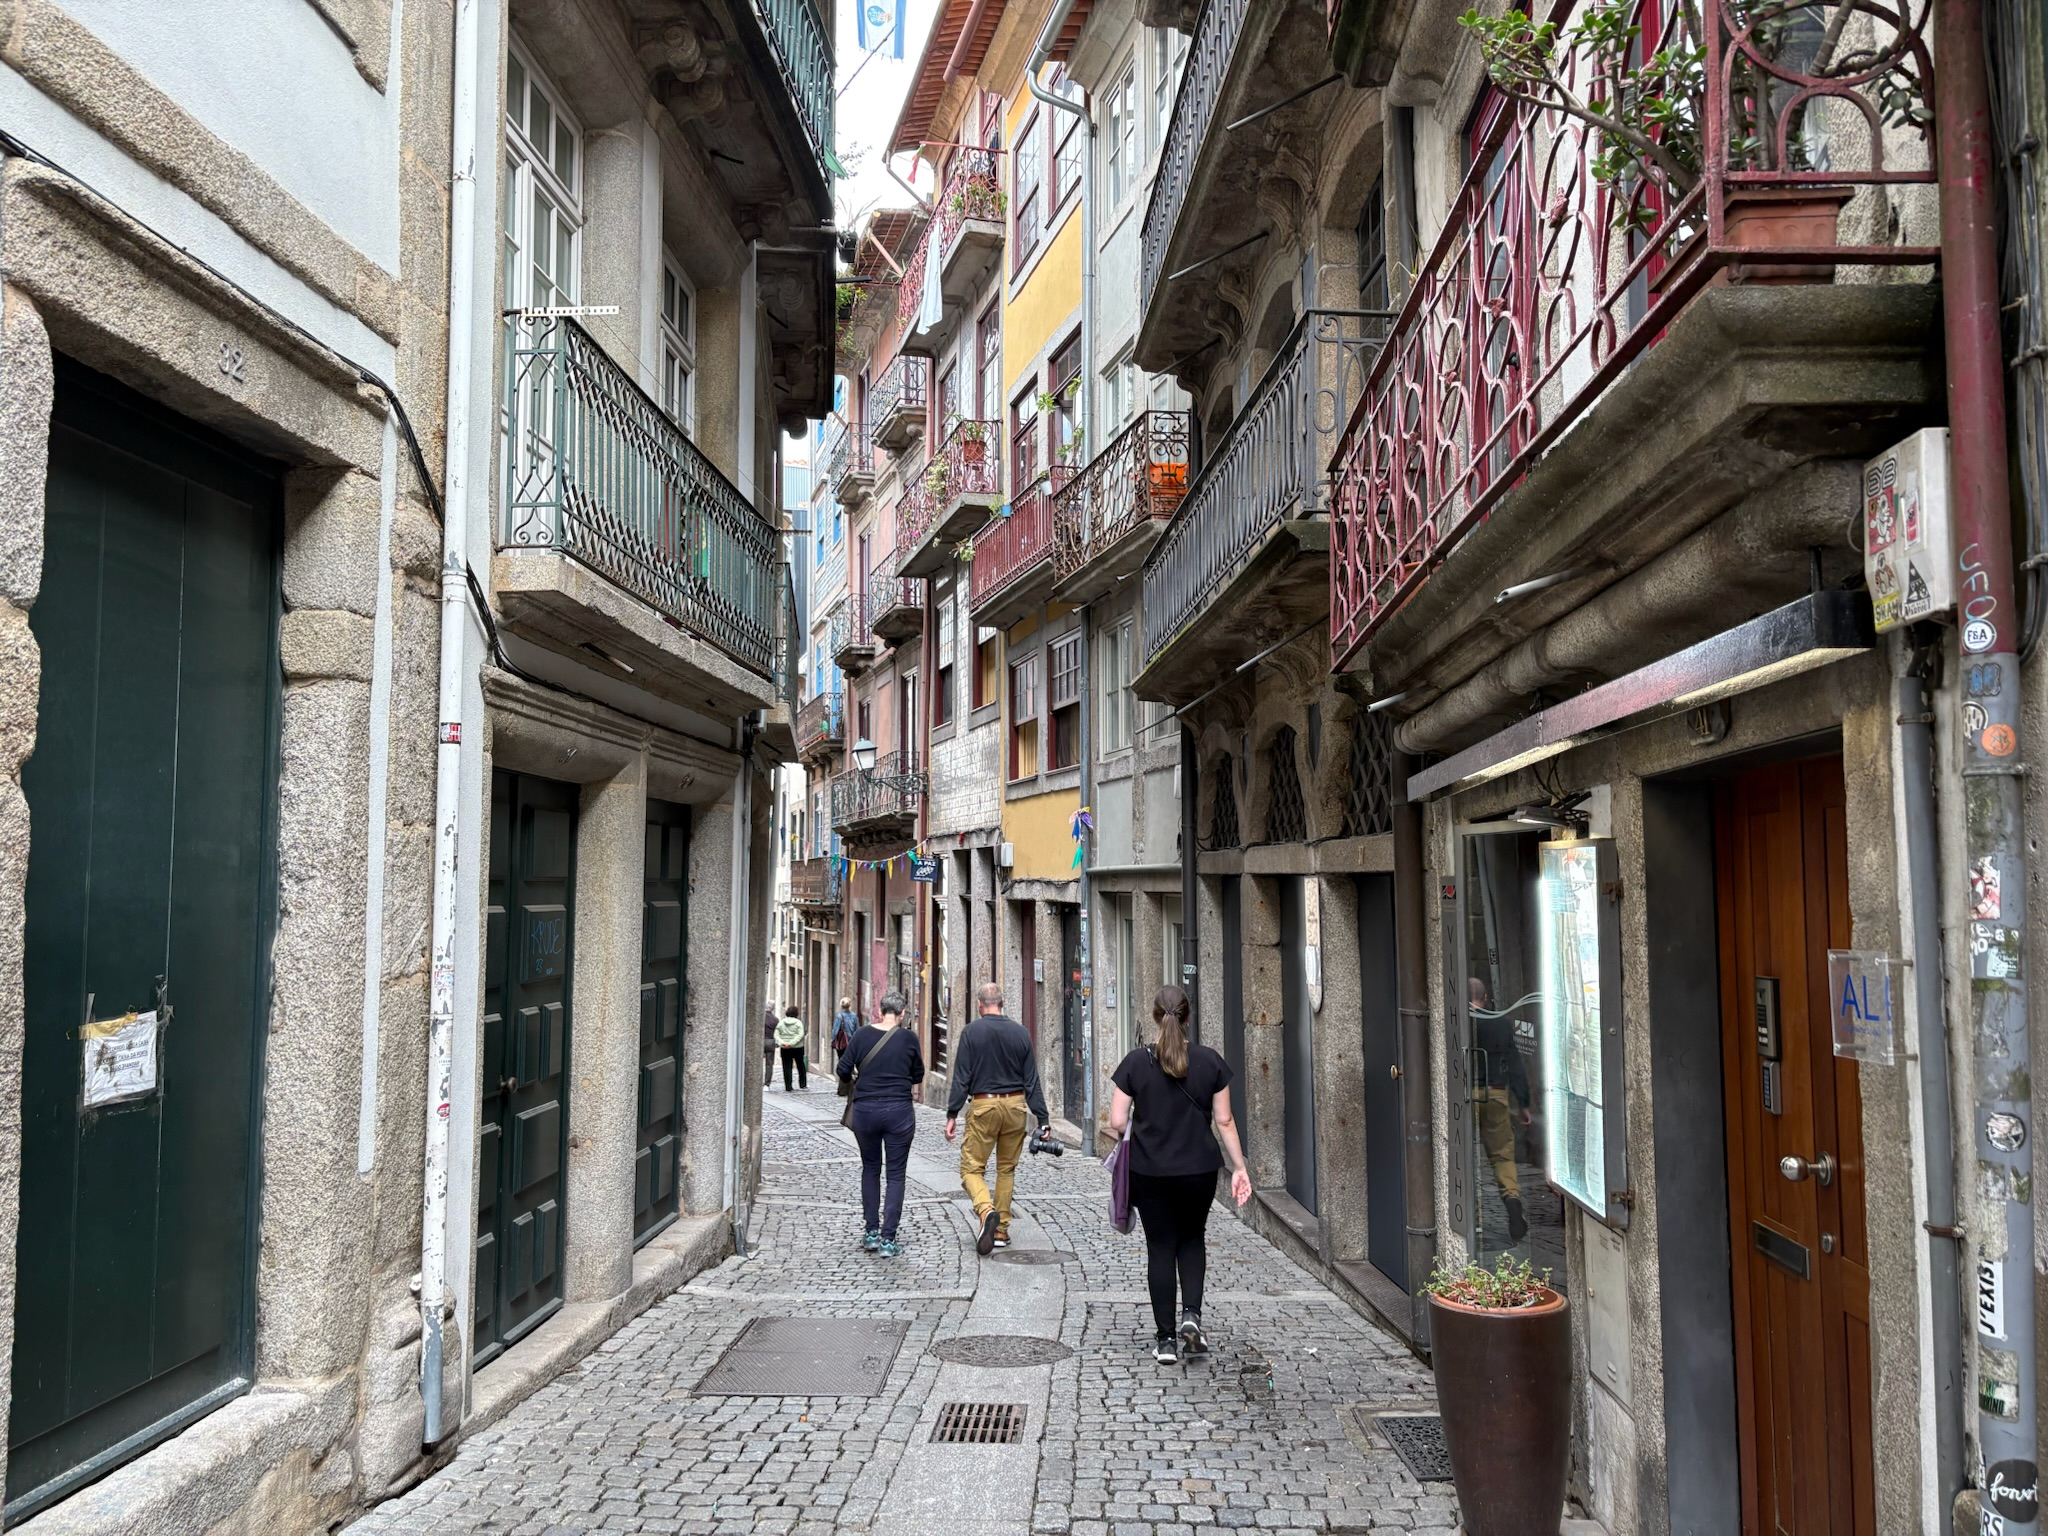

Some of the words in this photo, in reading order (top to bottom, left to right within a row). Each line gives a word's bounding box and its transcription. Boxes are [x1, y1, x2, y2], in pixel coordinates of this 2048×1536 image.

[217, 342, 244, 384] 32
[1967, 628, 1988, 642] F&A
[1446, 924, 1459, 1080] VINHAS
[1453, 1102, 1464, 1223] D'ALHO
